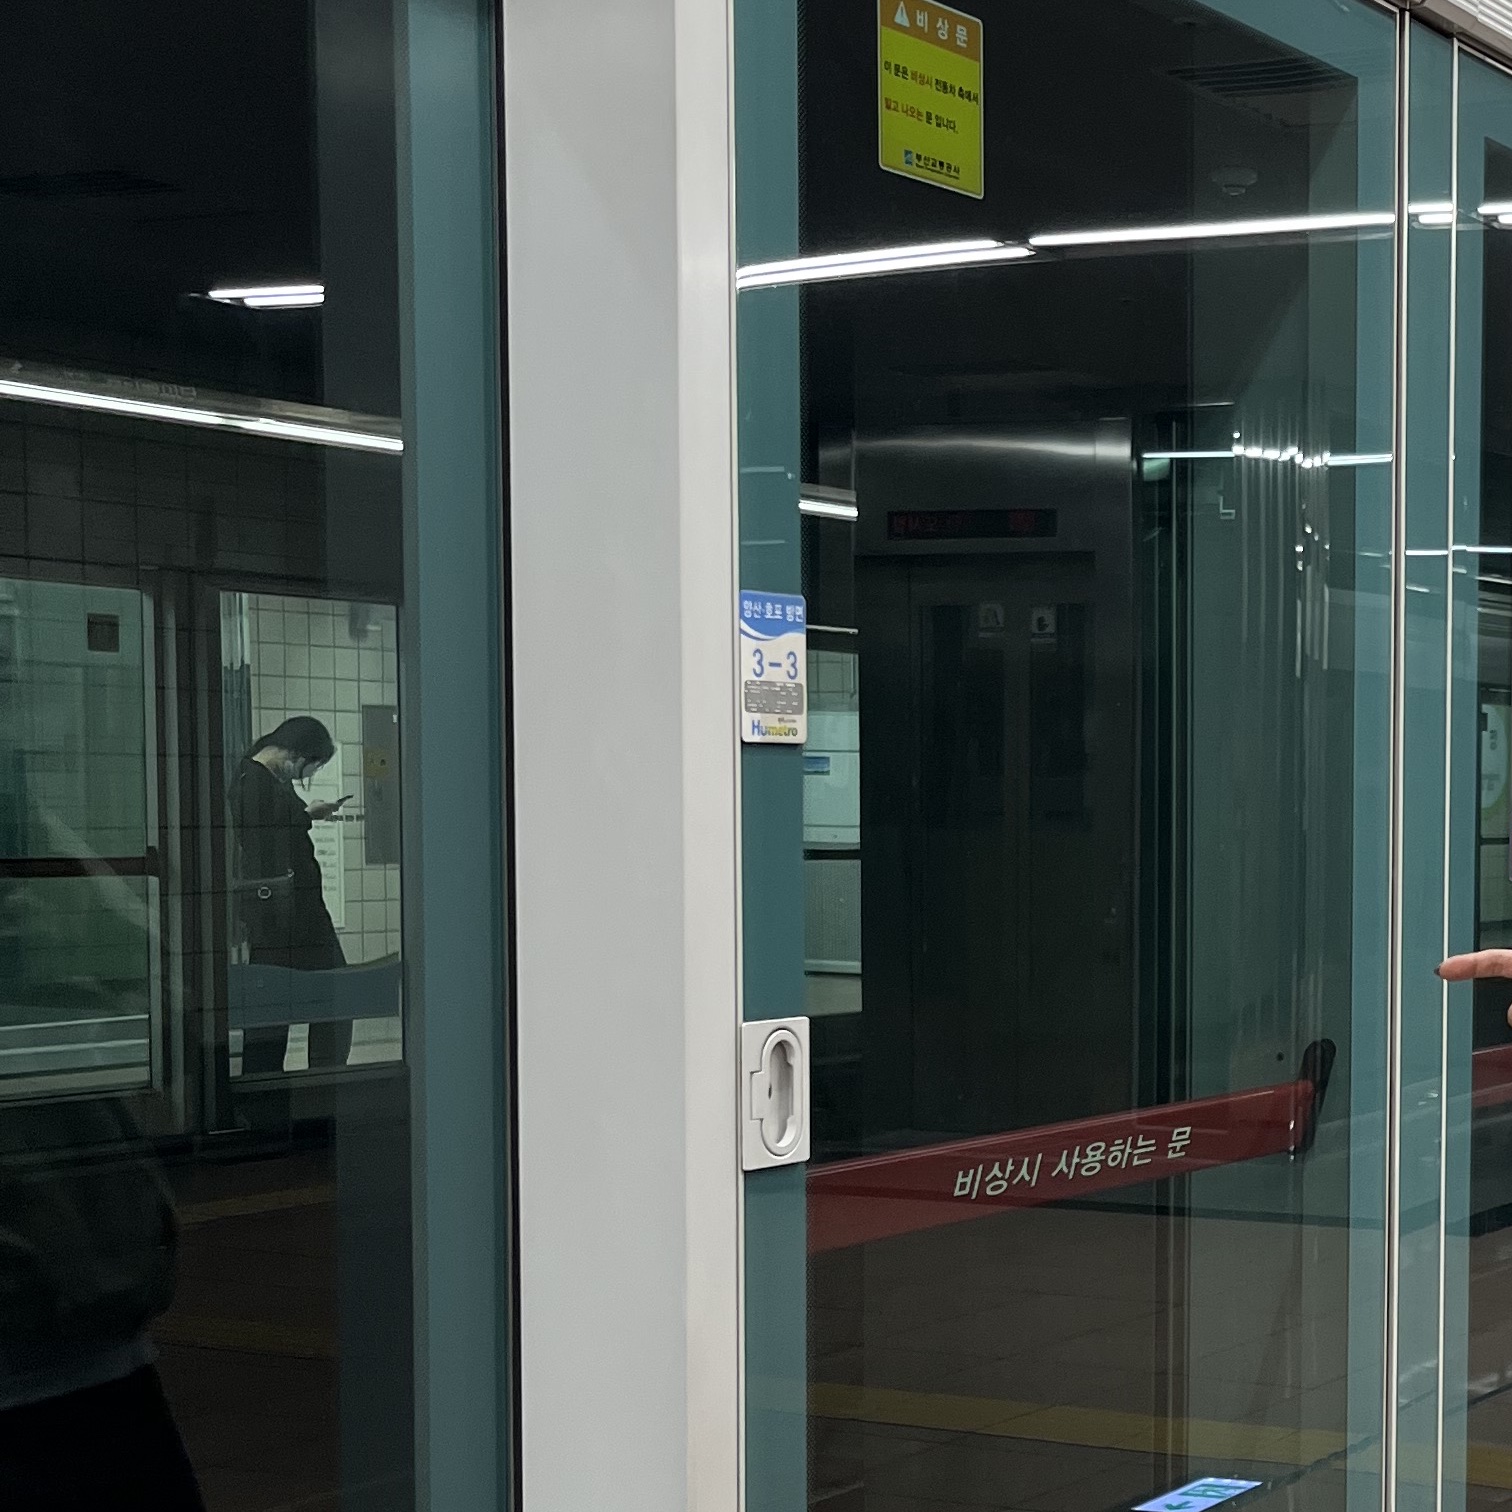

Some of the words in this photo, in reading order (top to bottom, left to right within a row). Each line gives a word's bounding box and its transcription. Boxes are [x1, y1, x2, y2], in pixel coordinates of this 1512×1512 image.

[884, 61, 892, 74] 이
[894, 63, 909, 80] 문은
[910, 70, 933, 89] 비상시
[935, 78, 956, 98] 전동차
[884, 97, 899, 113] 밀고
[901, 102, 923, 122] 나오는
[915, 152, 960, 175] 부산교통공사
[785, 604, 804, 623] 방면
[752, 648, 798, 680] 3-3
[752, 719, 798, 737] Humetro
[953, 1152, 1043, 1200] 비상시
[1051, 1135, 1156, 1180] 사용하는
[1167, 1126, 1192, 1159] 문
